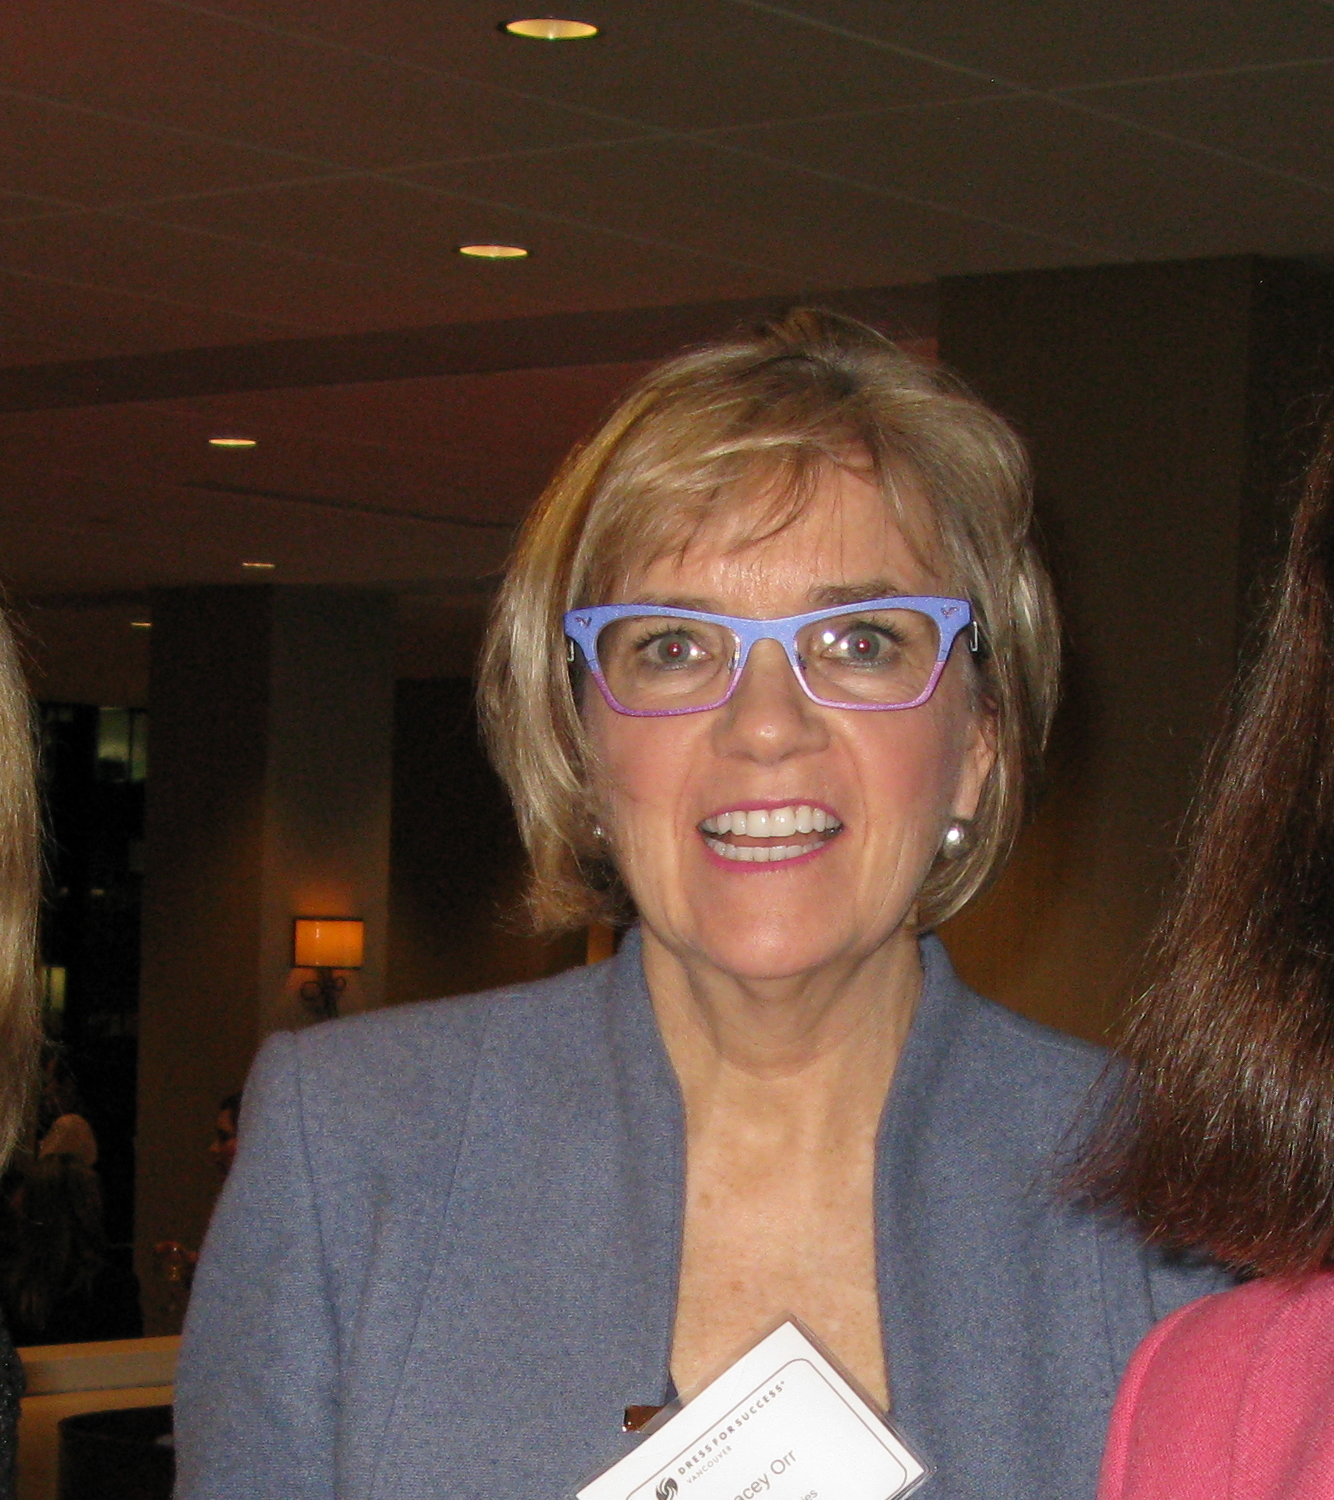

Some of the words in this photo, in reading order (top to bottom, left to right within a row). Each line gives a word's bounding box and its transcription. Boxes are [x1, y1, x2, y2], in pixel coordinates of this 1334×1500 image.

[677, 1444, 712, 1475] DRESS
[712, 1425, 734, 1445] FOR
[734, 1383, 783, 1426] SUCCESS
[686, 1445, 731, 1484] VANCOUVER
[770, 1450, 797, 1475] Orr
